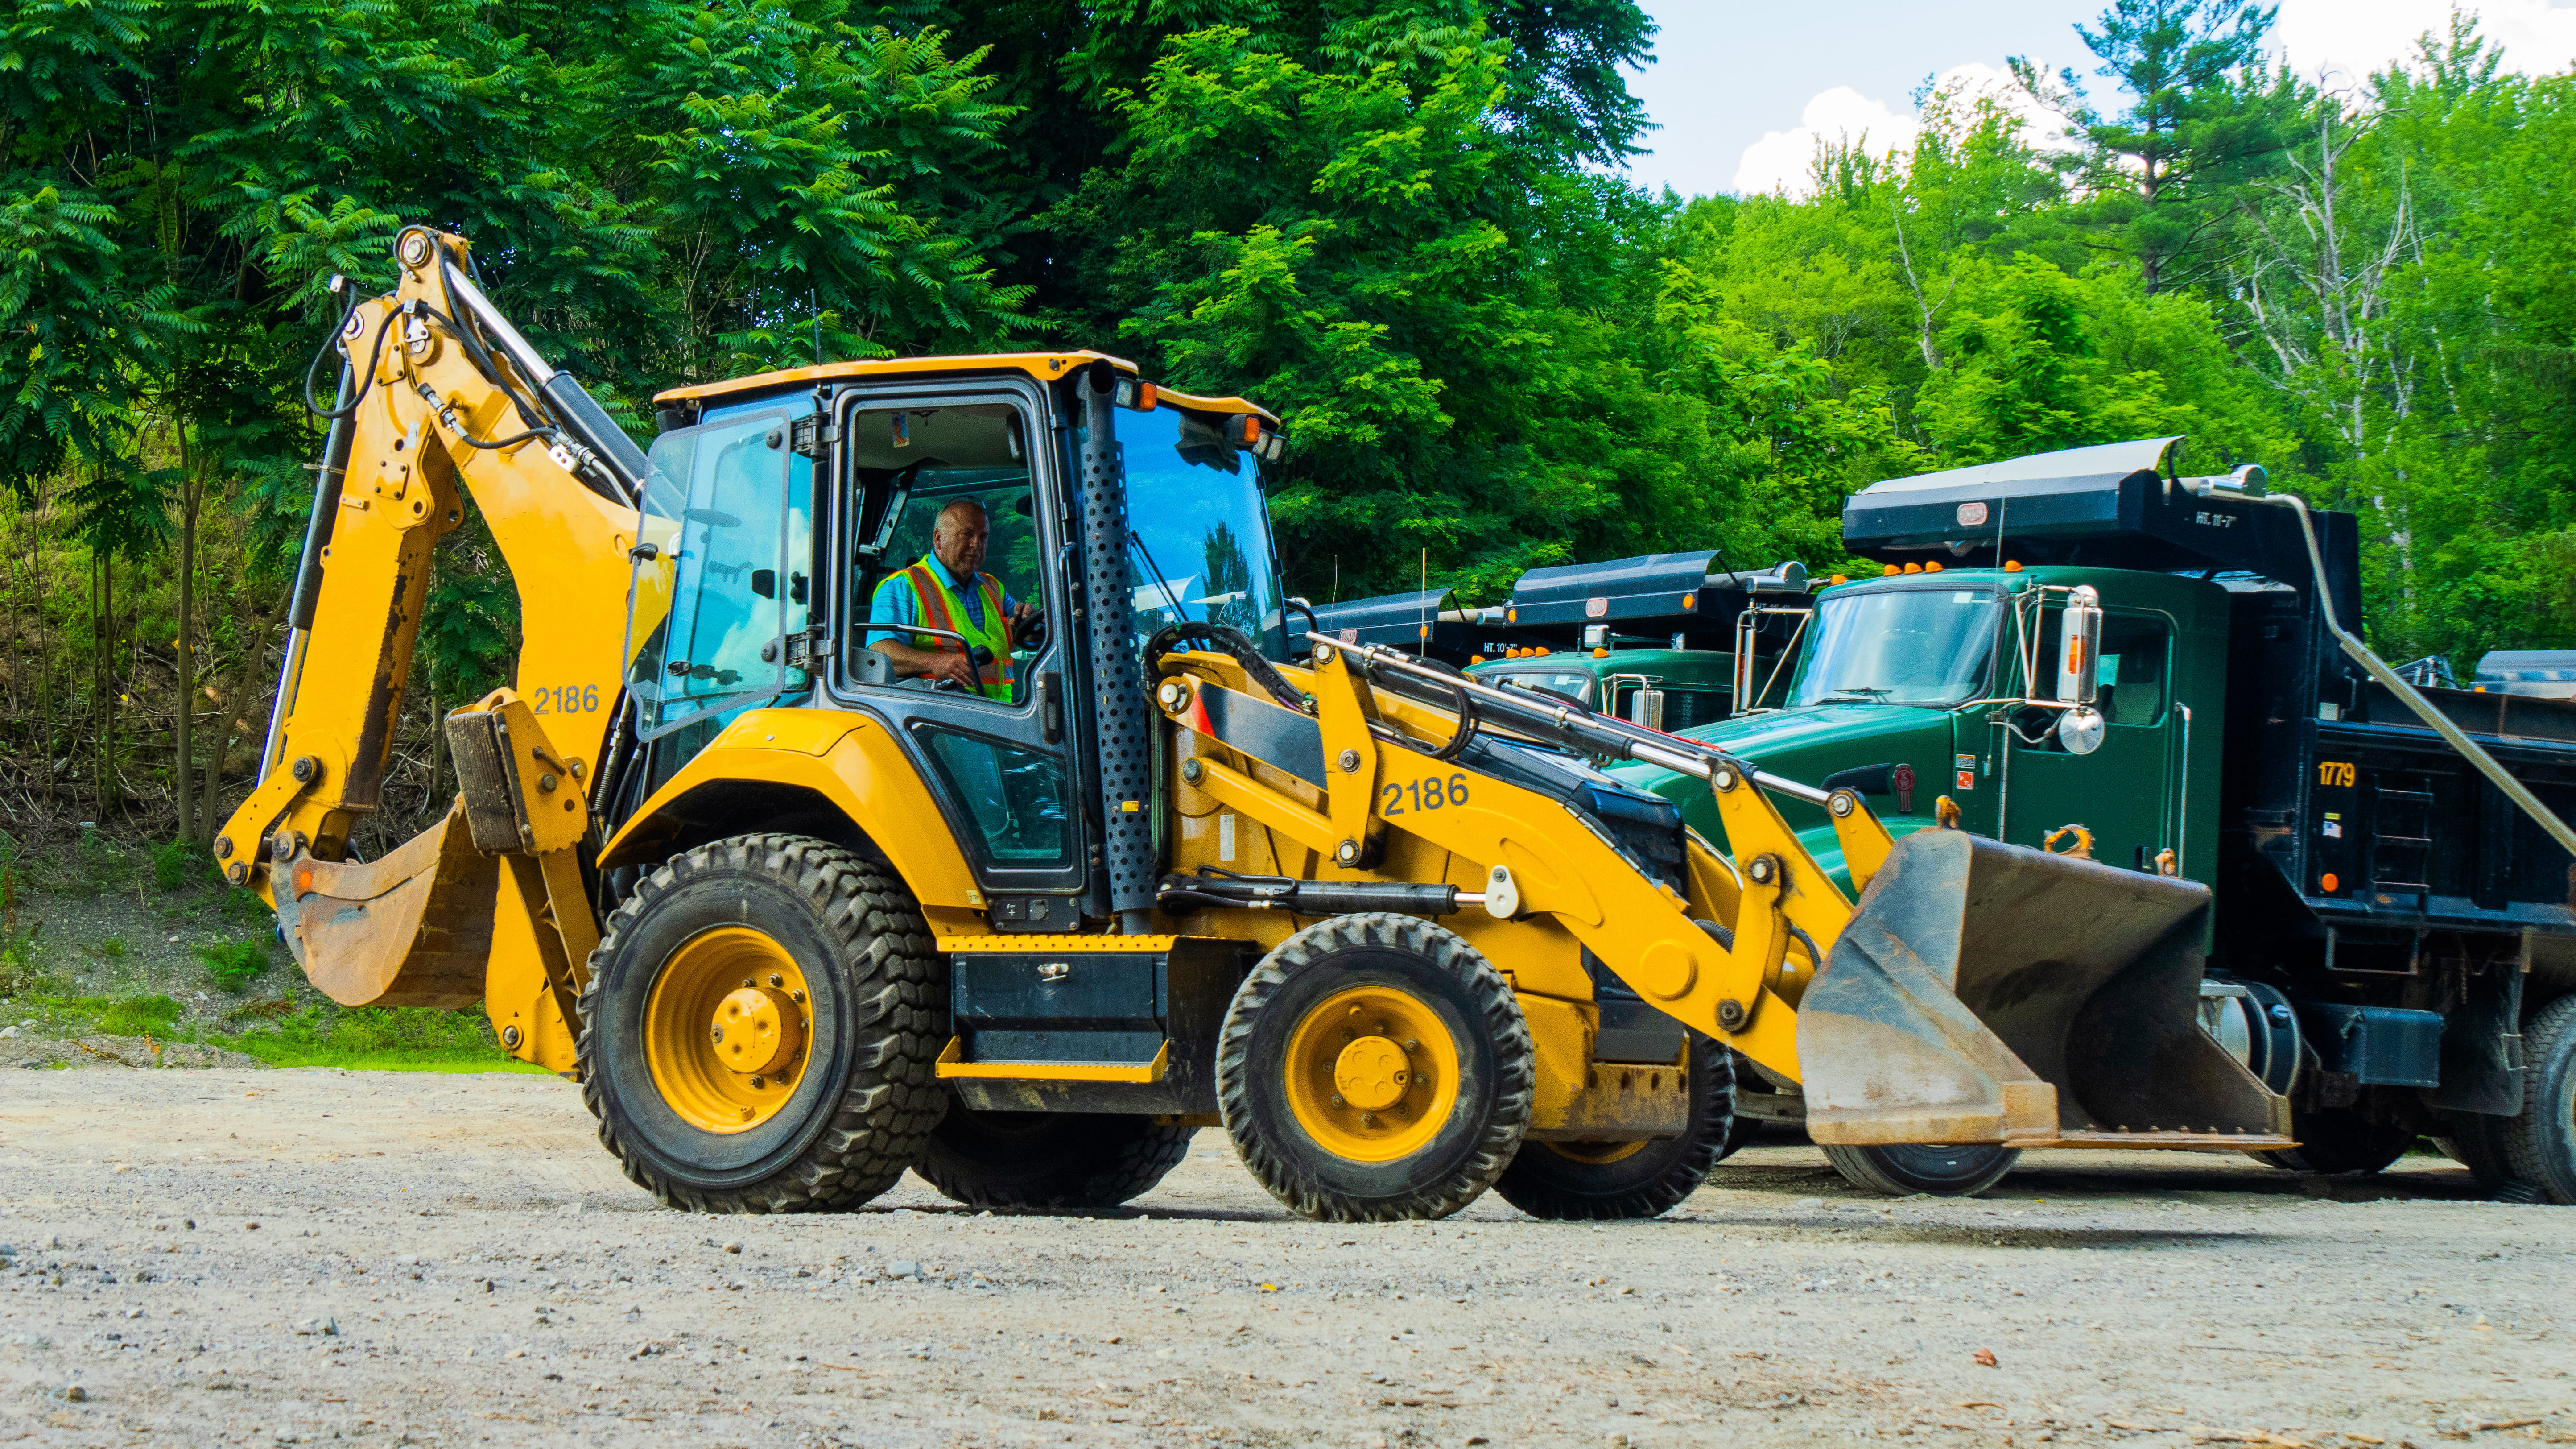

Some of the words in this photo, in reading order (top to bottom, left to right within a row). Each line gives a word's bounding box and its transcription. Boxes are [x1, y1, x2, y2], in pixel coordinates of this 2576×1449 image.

[2196, 511, 2212, 525] HT.
[1484, 642, 1495, 652] HT.
[534, 684, 598, 715] 2186
[2318, 761, 2356, 787] 1779
[1383, 773, 1468, 816] 2186
